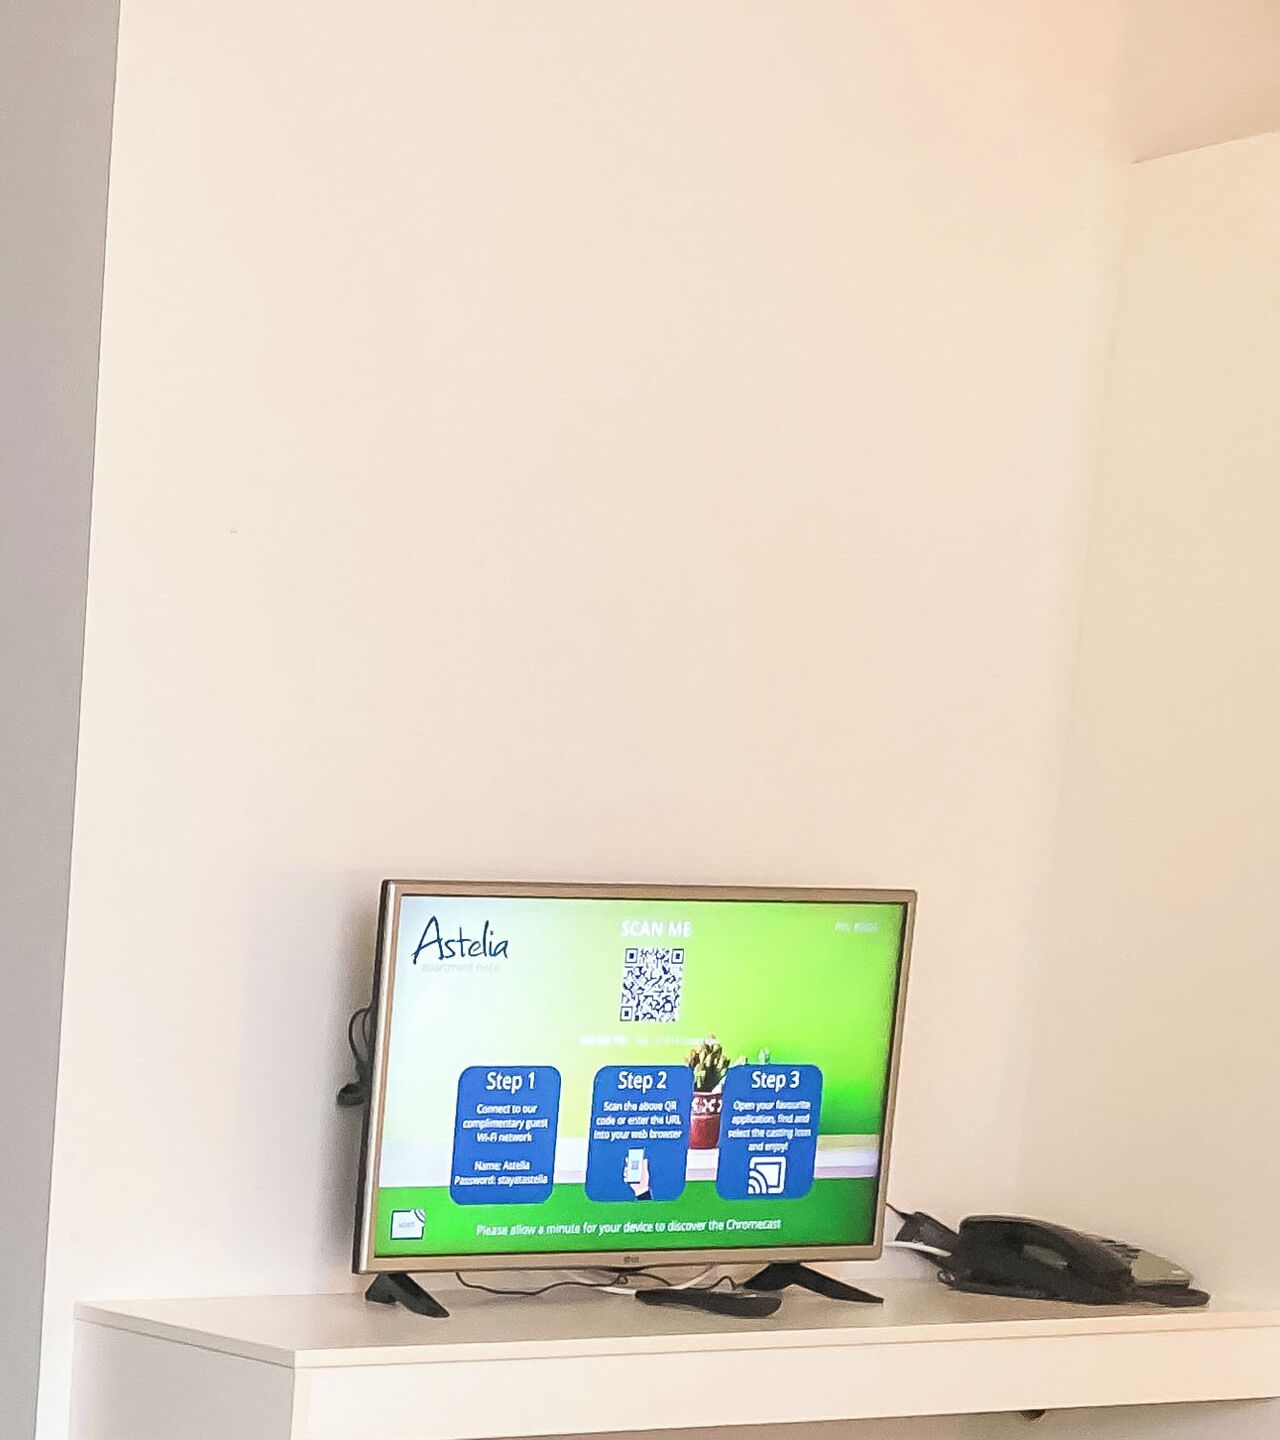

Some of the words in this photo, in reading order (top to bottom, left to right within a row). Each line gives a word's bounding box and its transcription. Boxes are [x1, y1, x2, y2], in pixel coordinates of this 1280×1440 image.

[621, 920, 663, 937] SCAN
[668, 921, 692, 938] ME
[411, 915, 509, 965] Astelia
[486, 1071, 523, 1095] Step
[528, 1071, 536, 1089] 1
[617, 1071, 654, 1094] Step
[656, 1071, 667, 1089] 2
[751, 1070, 787, 1093] Step
[789, 1070, 800, 1088] 3
[476, 1104, 511, 1114] Connect
[512, 1104, 521, 1114] to
[522, 1105, 538, 1114] our
[603, 1101, 622, 1112] Scan
[624, 1101, 638, 1112] the
[639, 1101, 663, 1112] above
[664, 1100, 677, 1112] QR
[733, 1100, 756, 1112] Open
[756, 1102, 775, 1113] your
[462, 1118, 525, 1130] complimentary
[526, 1119, 548, 1130] guest
[596, 1116, 616, 1126] code
[617, 1116, 627, 1125] or
[627, 1116, 650, 1126] enter
[650, 1115, 664, 1125] the
[498, 1132, 532, 1142] network
[610, 1130, 630, 1142] your
[631, 1129, 648, 1139] web
[649, 1129, 682, 1139] browser
[751, 1129, 765, 1138] the
[748, 1142, 764, 1151] and
[764, 1142, 788, 1153] enjoy!
[474, 1160, 501, 1171] Name:
[502, 1160, 530, 1170] Astelia
[454, 1176, 496, 1185] Password:
[476, 1224, 508, 1236] Please
[510, 1224, 536, 1236] allow
[538, 1226, 544, 1234] a
[546, 1223, 580, 1234] minute
[582, 1222, 598, 1234] for
[598, 1223, 622, 1236] your
[623, 1221, 654, 1232] device
[654, 1222, 666, 1232] to
[668, 1220, 706, 1232] discover
[708, 1220, 725, 1230] the
[726, 1218, 782, 1230] Chromecast
